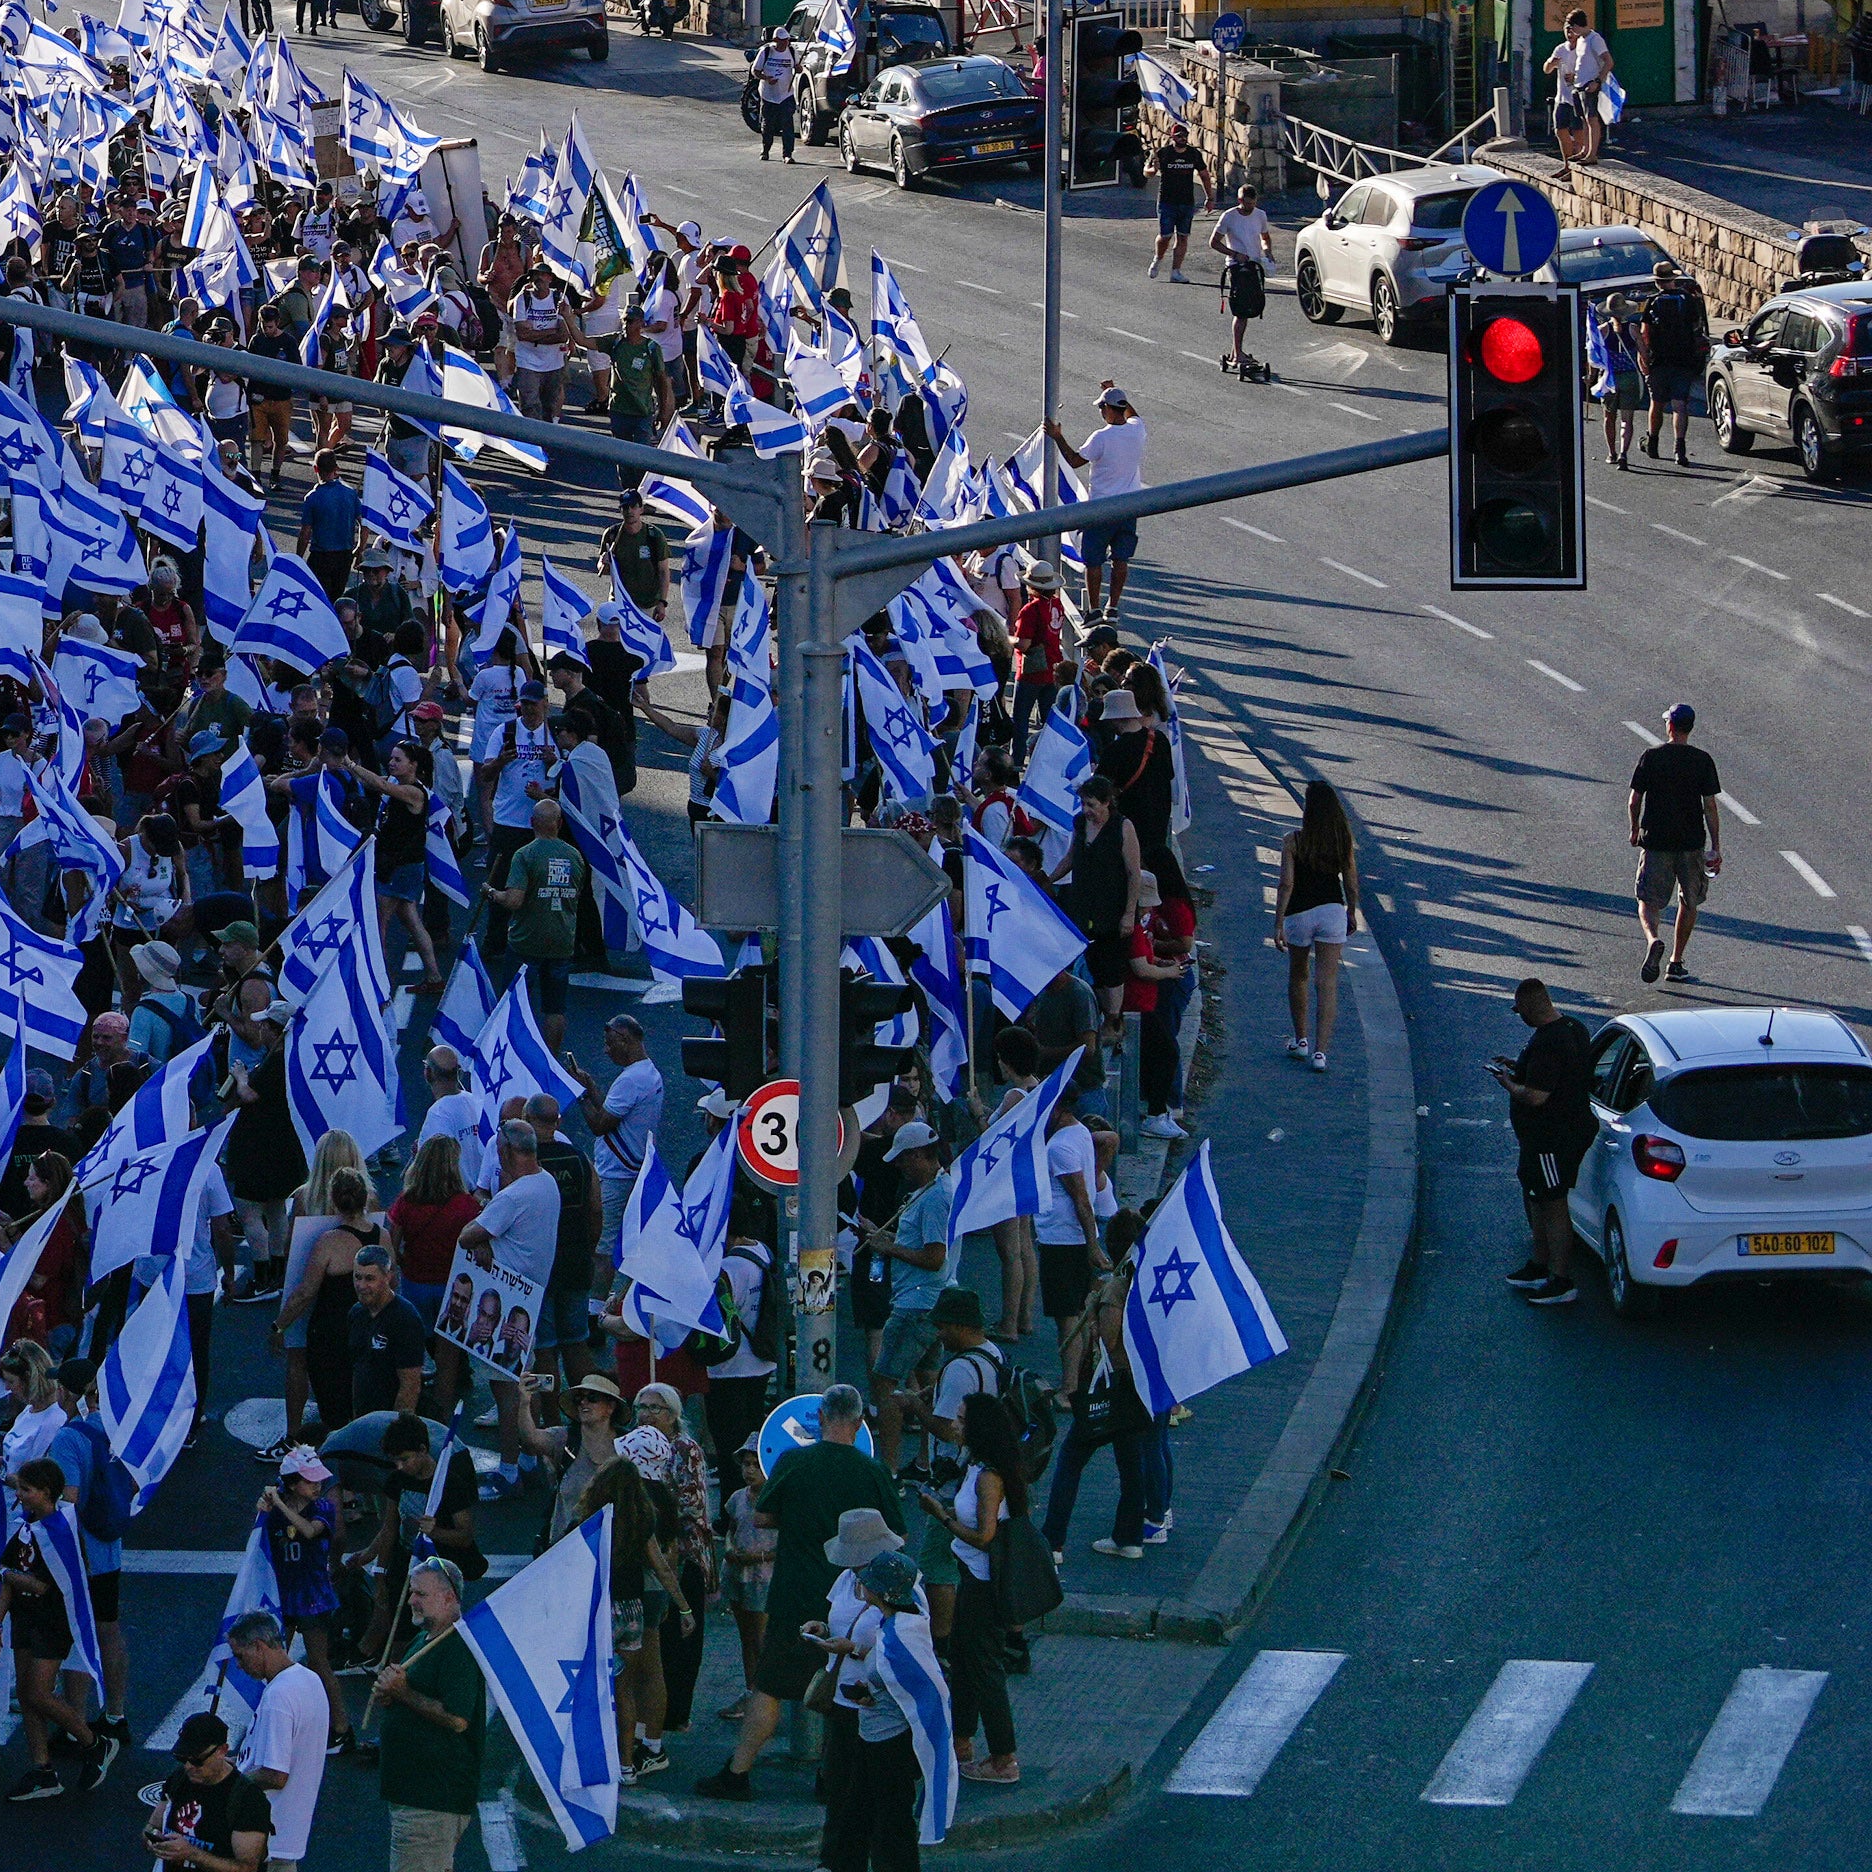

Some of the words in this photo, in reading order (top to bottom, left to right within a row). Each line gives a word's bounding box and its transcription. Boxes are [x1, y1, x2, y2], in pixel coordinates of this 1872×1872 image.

[1214, 25, 1243, 39] יציאה
[760, 1112, 799, 1156] 3
[813, 1338, 831, 1373] 8
[284, 1541, 301, 1562] 10
